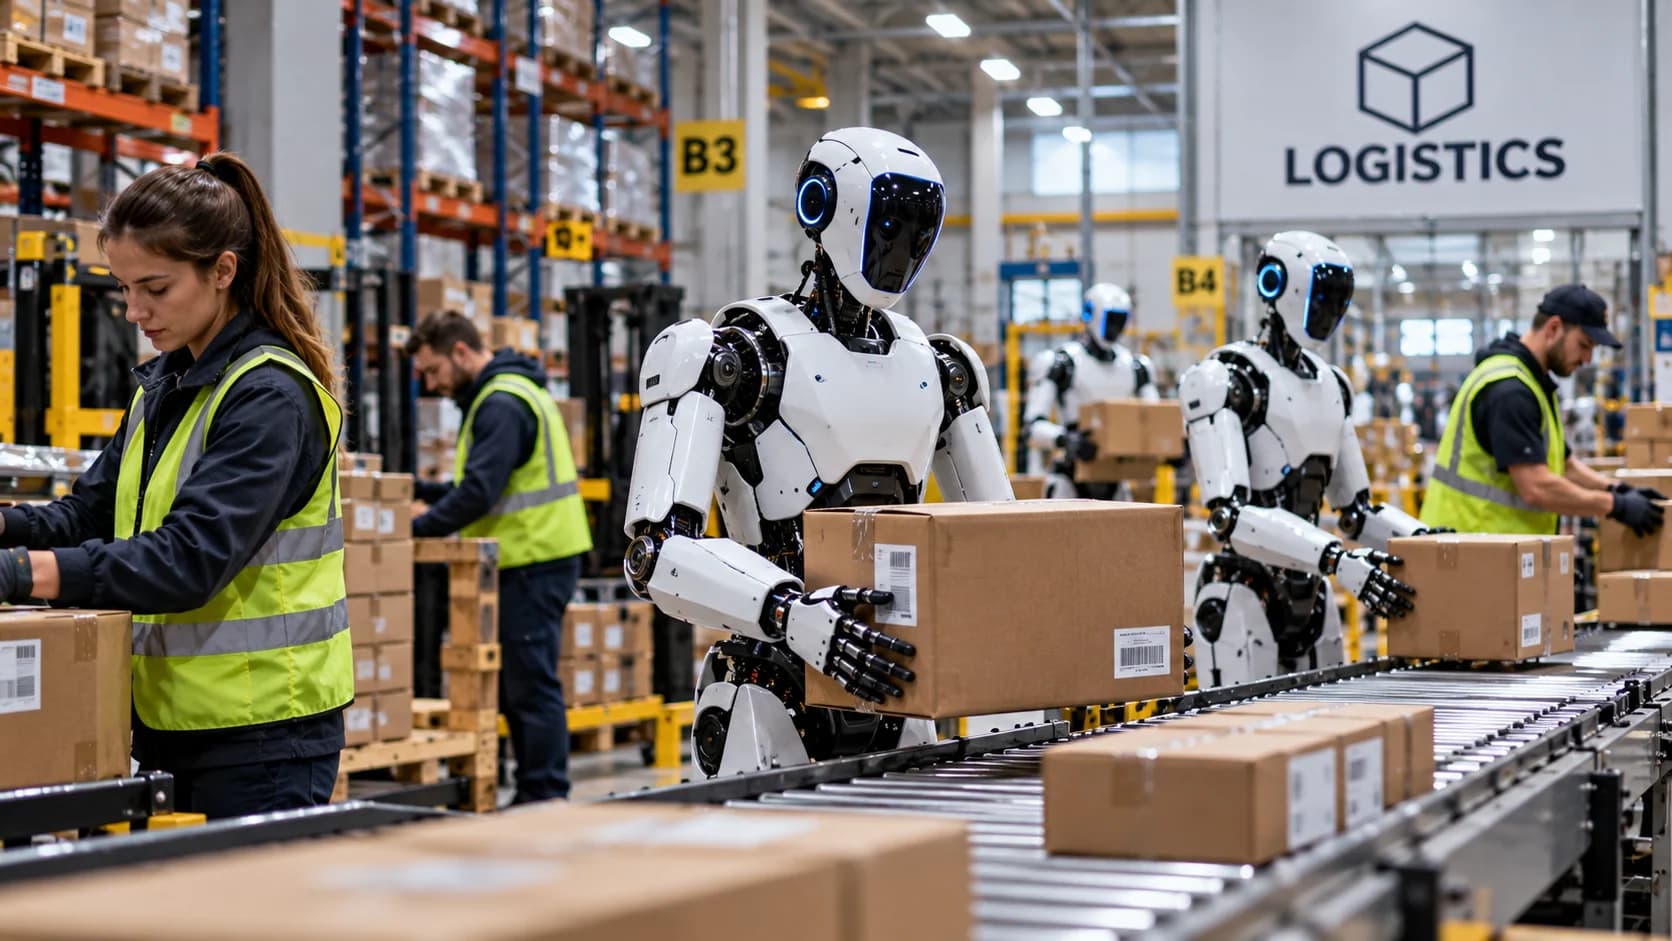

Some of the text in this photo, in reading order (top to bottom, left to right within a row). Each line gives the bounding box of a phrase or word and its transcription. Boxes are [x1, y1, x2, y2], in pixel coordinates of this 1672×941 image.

[683, 136, 737, 175] B3
[1285, 138, 1566, 186] LOGISTICS
[1178, 268, 1216, 294] B4
